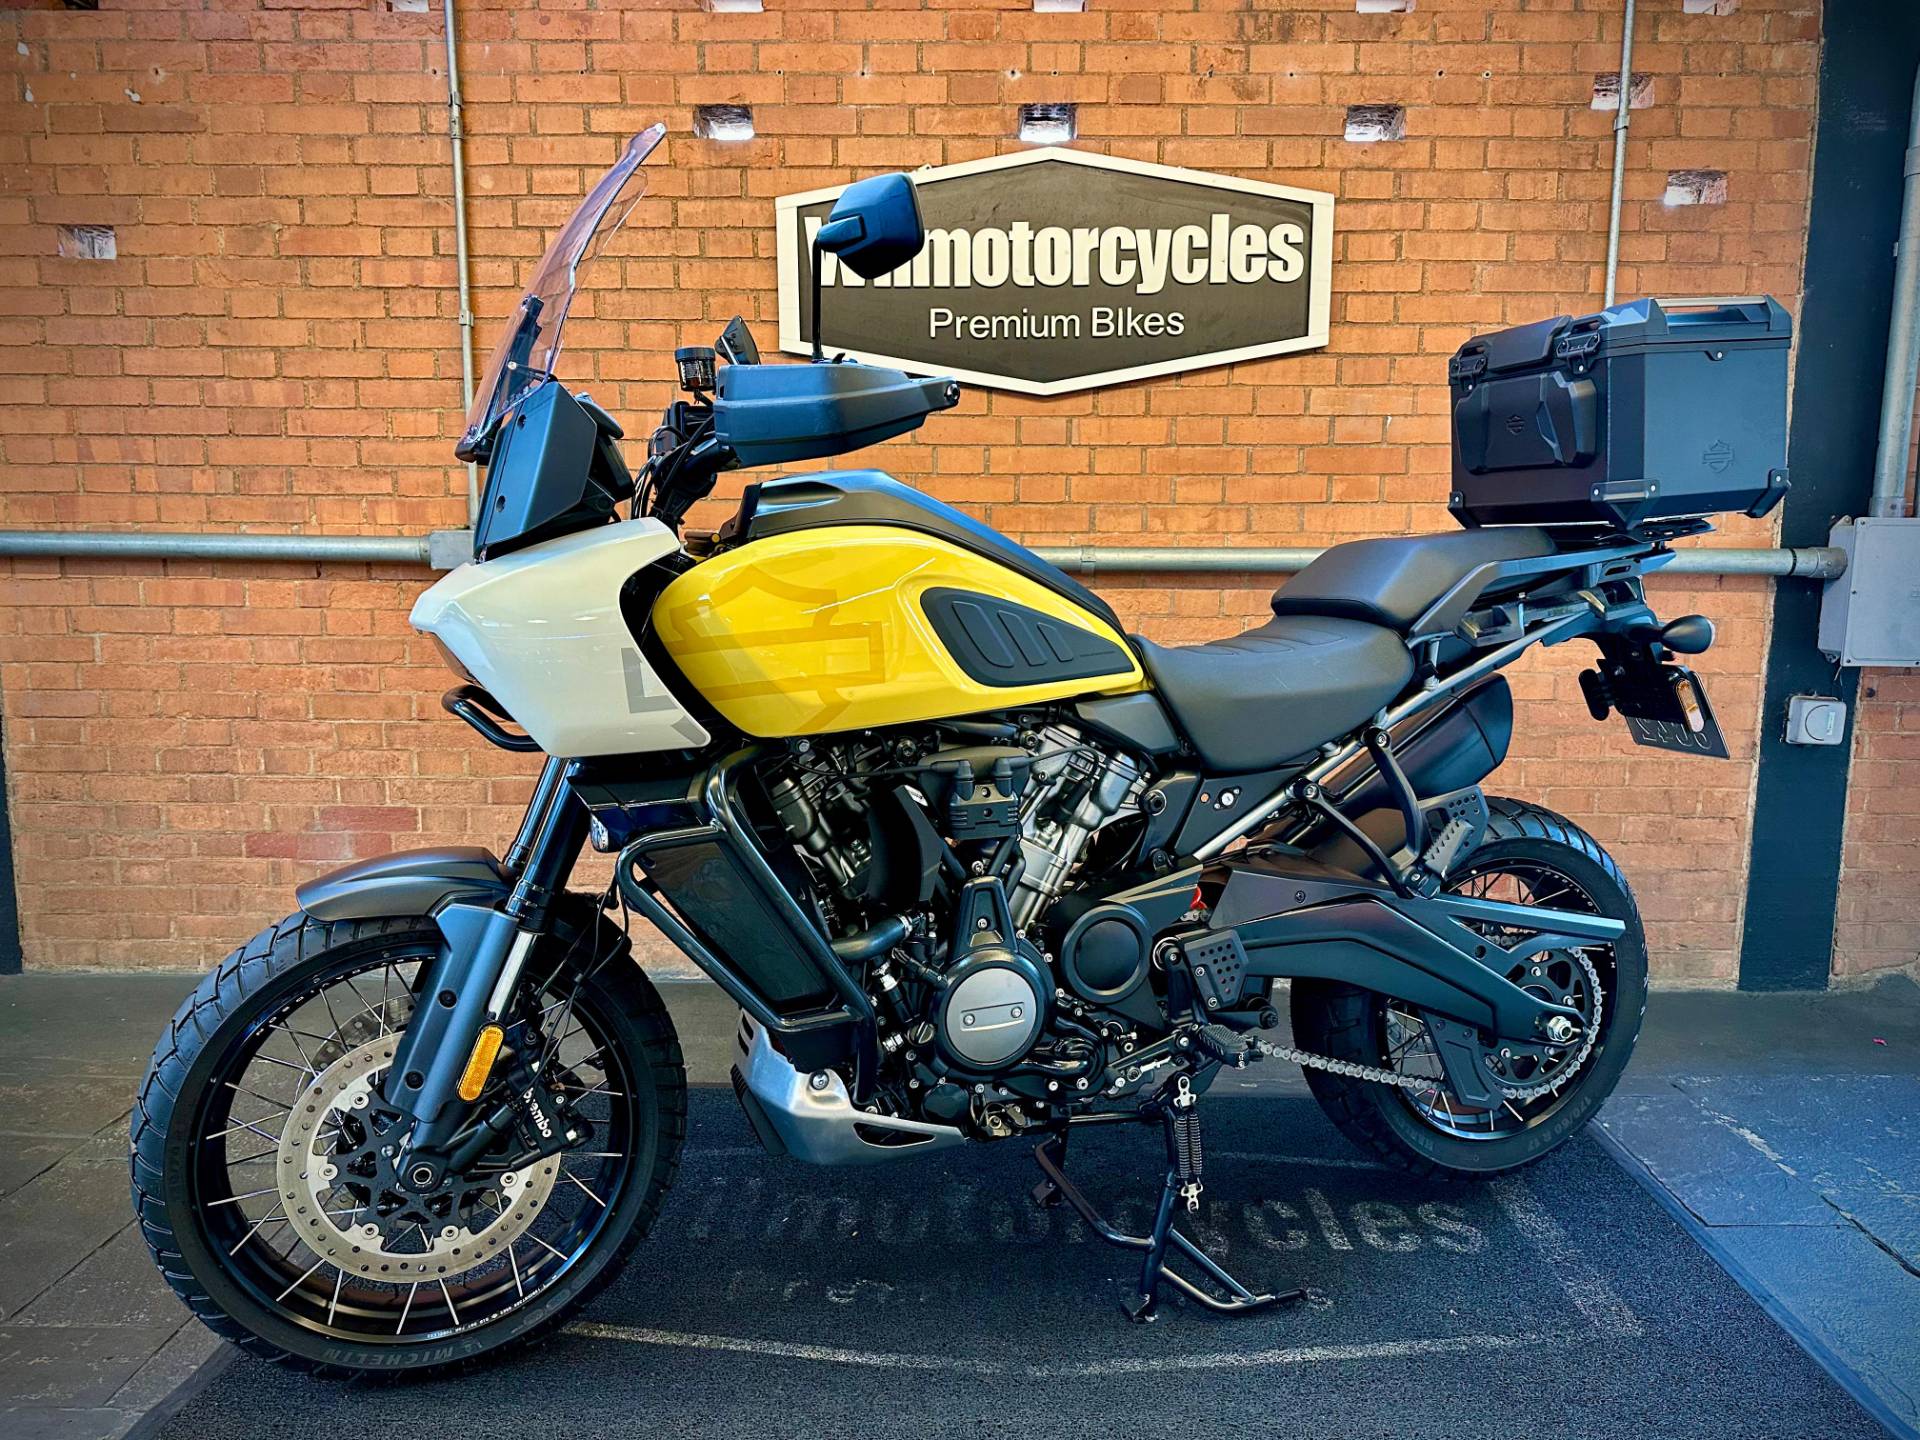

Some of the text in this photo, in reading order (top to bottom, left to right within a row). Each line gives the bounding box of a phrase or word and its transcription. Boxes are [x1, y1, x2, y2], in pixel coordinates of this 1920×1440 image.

[804, 214, 1304, 294] Wmotorcycles
[929, 308, 1080, 339] Premium
[322, 1347, 454, 1367] MICHELIN
